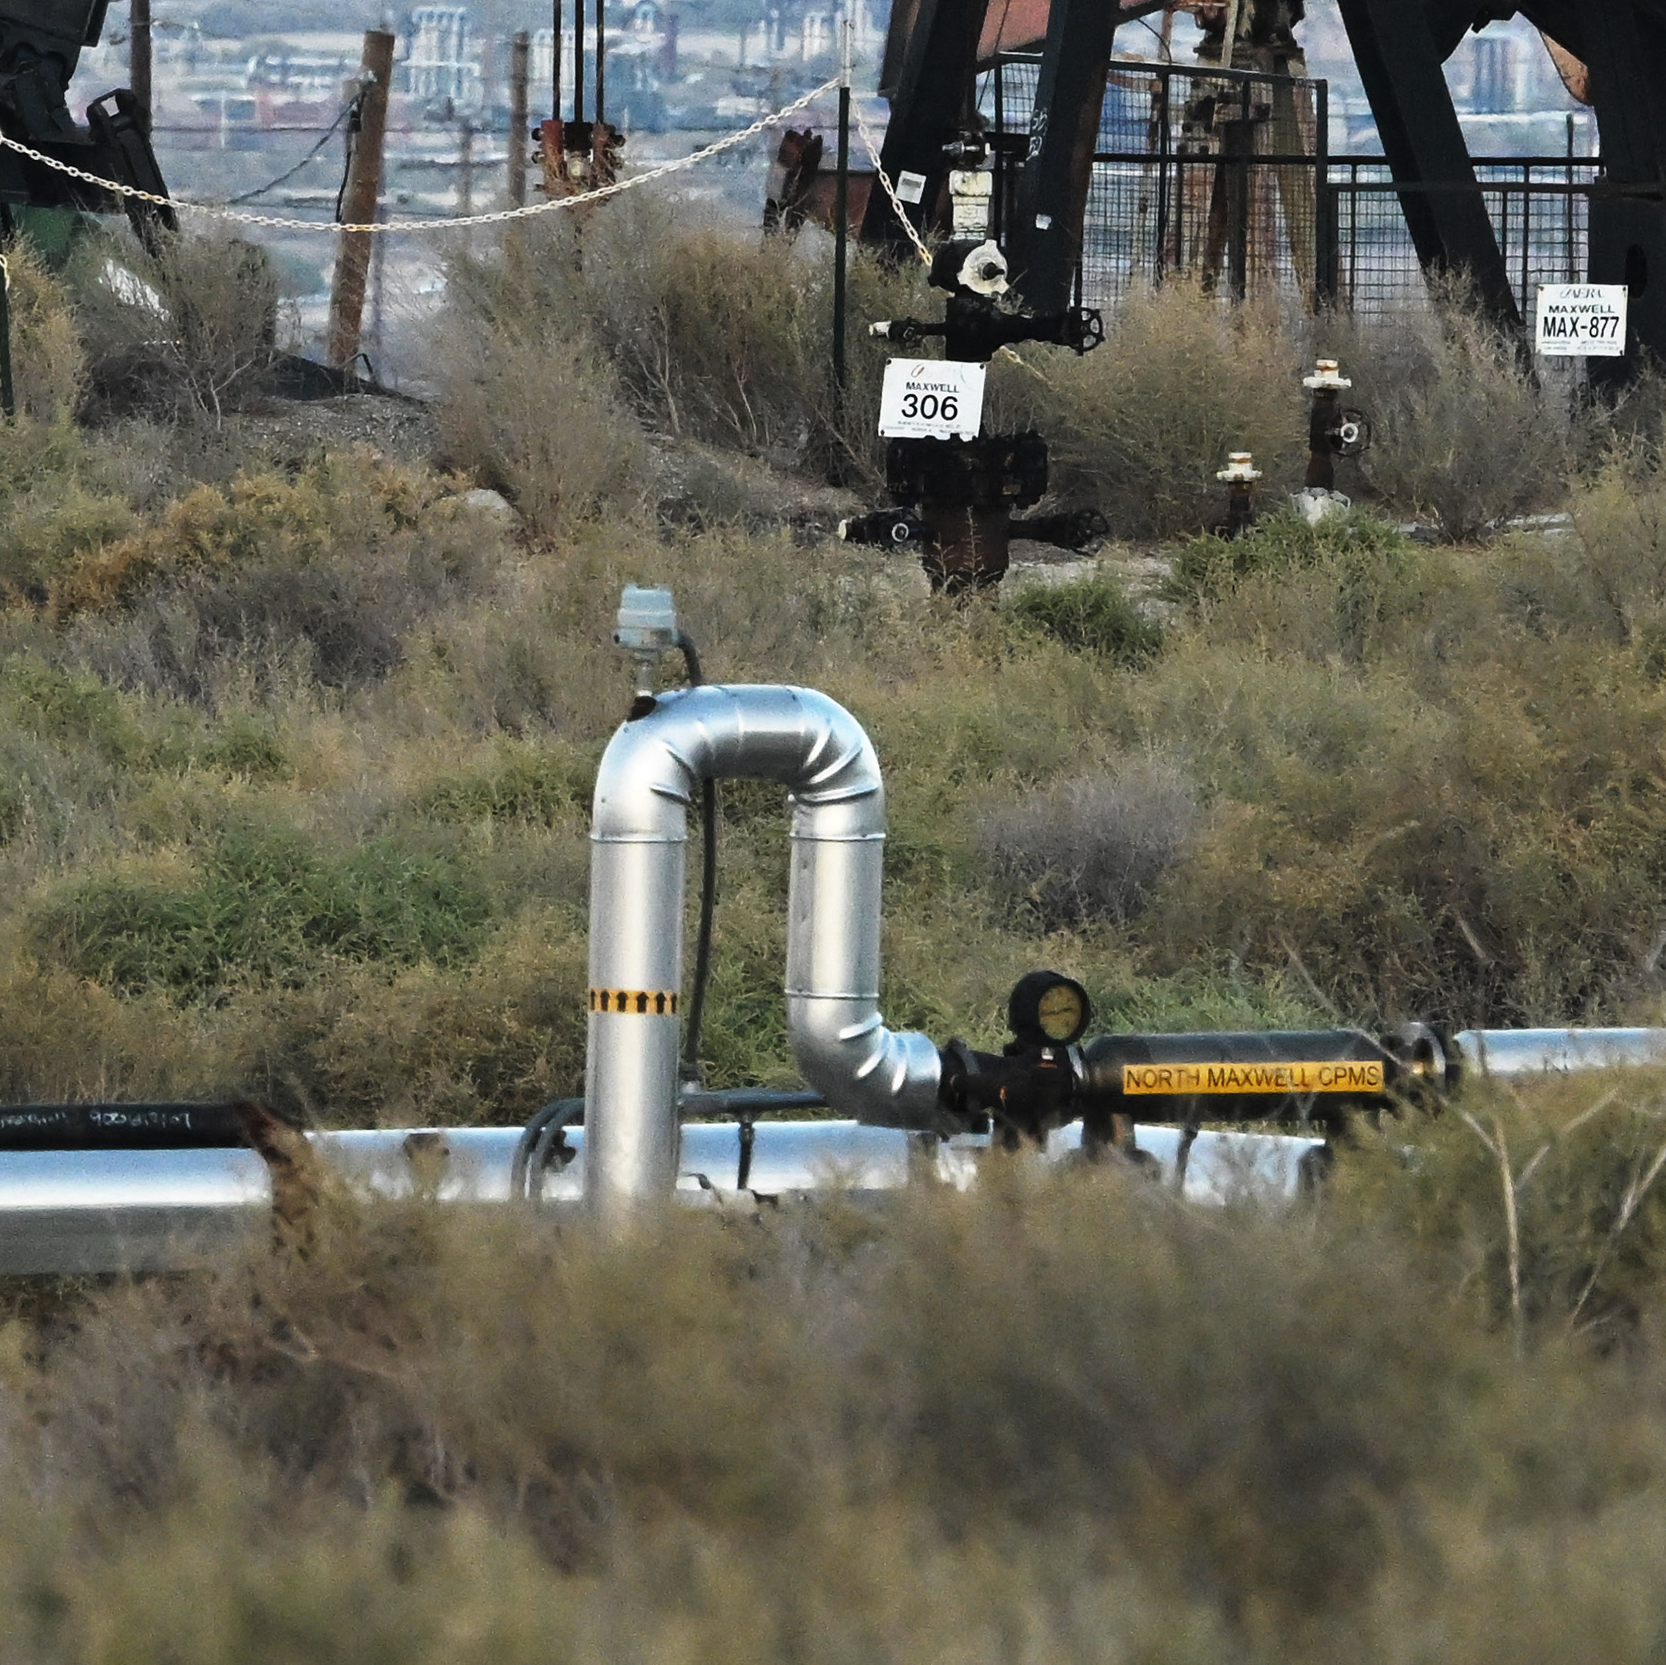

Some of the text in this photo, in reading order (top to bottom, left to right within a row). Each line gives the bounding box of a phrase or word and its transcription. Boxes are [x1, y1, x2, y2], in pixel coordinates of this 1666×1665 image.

[1548, 304, 1615, 314] MAXWELL
[1542, 315, 1620, 339] MAX-877
[905, 381, 960, 393] MAXWELL
[901, 393, 958, 421] 306
[1126, 1066, 1381, 1090] NORTH MAXWELL CPMS
